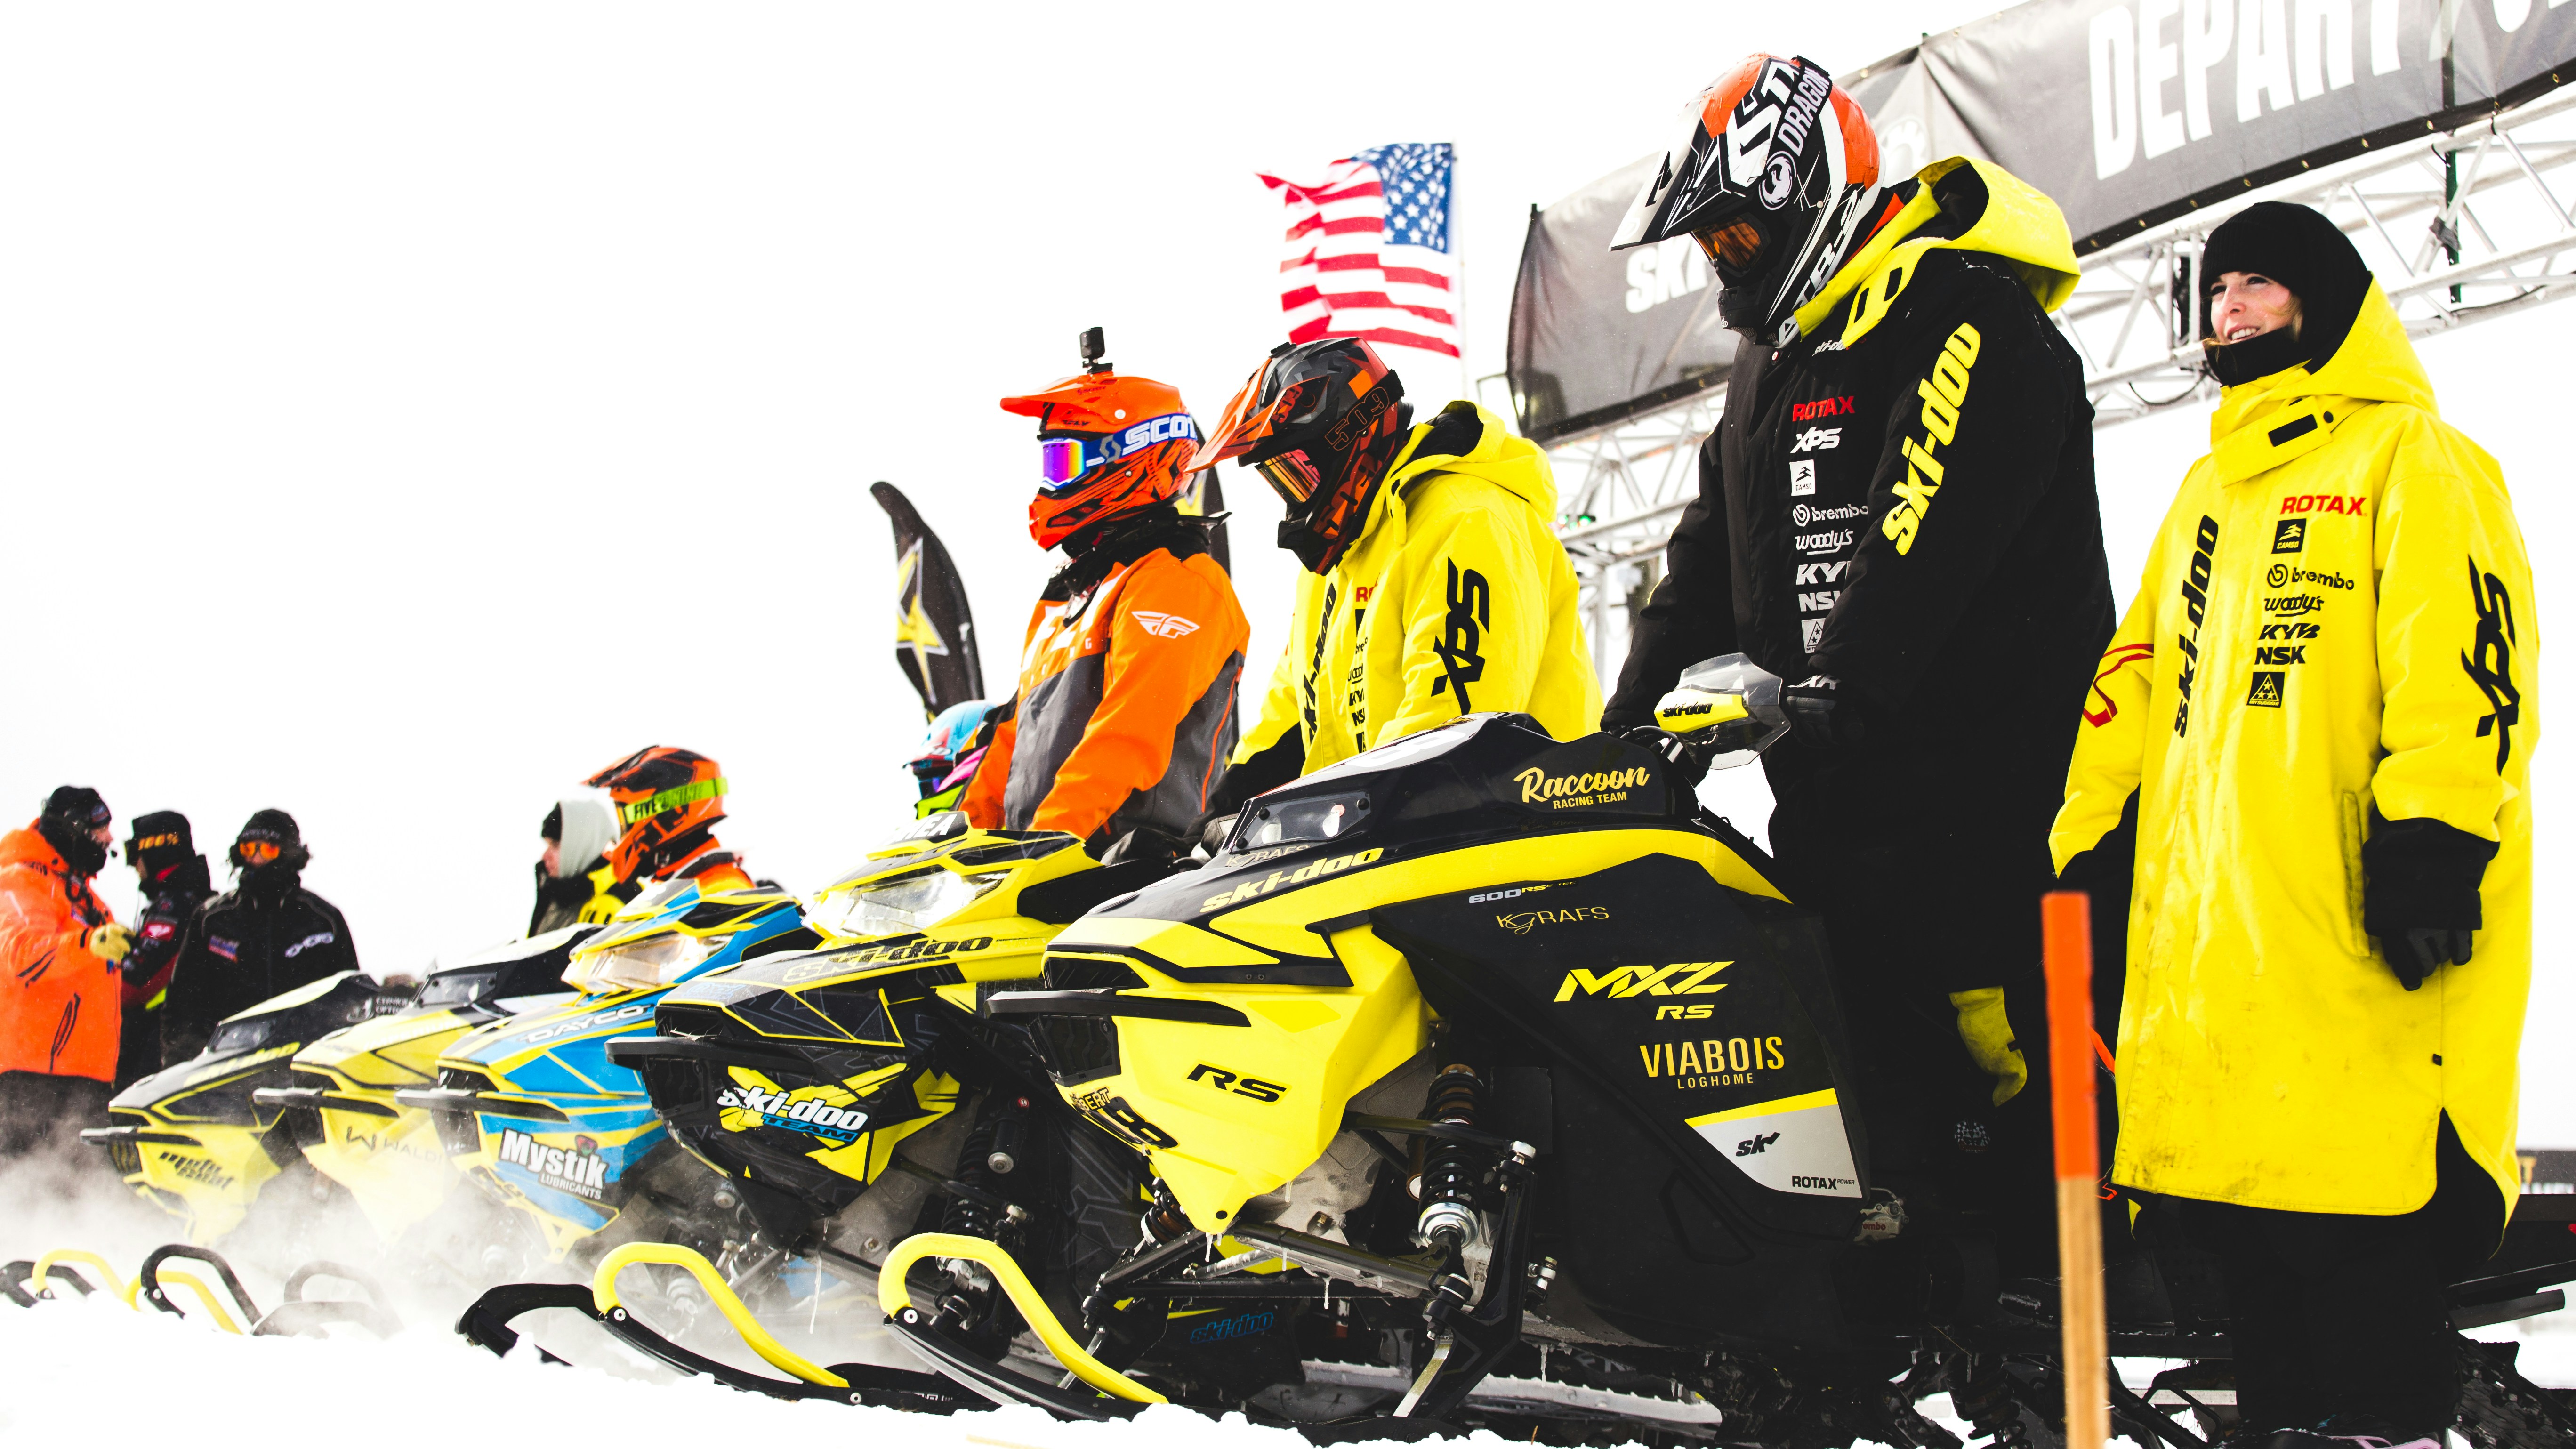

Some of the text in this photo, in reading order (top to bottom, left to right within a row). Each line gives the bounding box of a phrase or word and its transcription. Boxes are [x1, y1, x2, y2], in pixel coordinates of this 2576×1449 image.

[1778, 66, 1830, 157] DRAGON
[1324, 387, 1390, 451] 509
[1792, 396, 1855, 422] ROTAX
[1790, 427, 1842, 453] XPS
[1882, 322, 1980, 556] ski-doo
[1795, 483, 1812, 491] CAMSO
[2280, 495, 2367, 516] ROTAX
[1795, 528, 1853, 555] woody's
[2277, 541, 2299, 549] CAMSO
[2291, 567, 2354, 590] brembo
[2264, 593, 2325, 617] woody's
[2174, 514, 2219, 739] ski-doo
[2258, 623, 2320, 640] KYB
[2254, 645, 2306, 665] NSK
[2461, 554, 2521, 776] XPS
[1663, 702, 1713, 718] ski-doo
[1513, 766, 1650, 804] Raccoon
[1553, 791, 1627, 810] RACING TEAM
[1200, 847, 1384, 913] ski-doo
[1496, 907, 1610, 935] KGRAFS
[1554, 961, 1735, 1002] MXZ
[526, 1005, 646, 1044] DAYCO
[1655, 1004, 1715, 1020] RS
[1639, 1036, 1785, 1078] VIABOIS
[1187, 1063, 1287, 1103] RS
[1677, 1072, 1754, 1089] LOGHOME
[717, 1086, 869, 1131] ski-doo
[765, 1114, 856, 1141] TEAM
[500, 1129, 606, 1189] Mystik
[540, 1175, 602, 1201] LUBRICANTS
[1792, 1175, 1837, 1190] ROTAX
[1190, 1312, 1273, 1344] ski-doo
